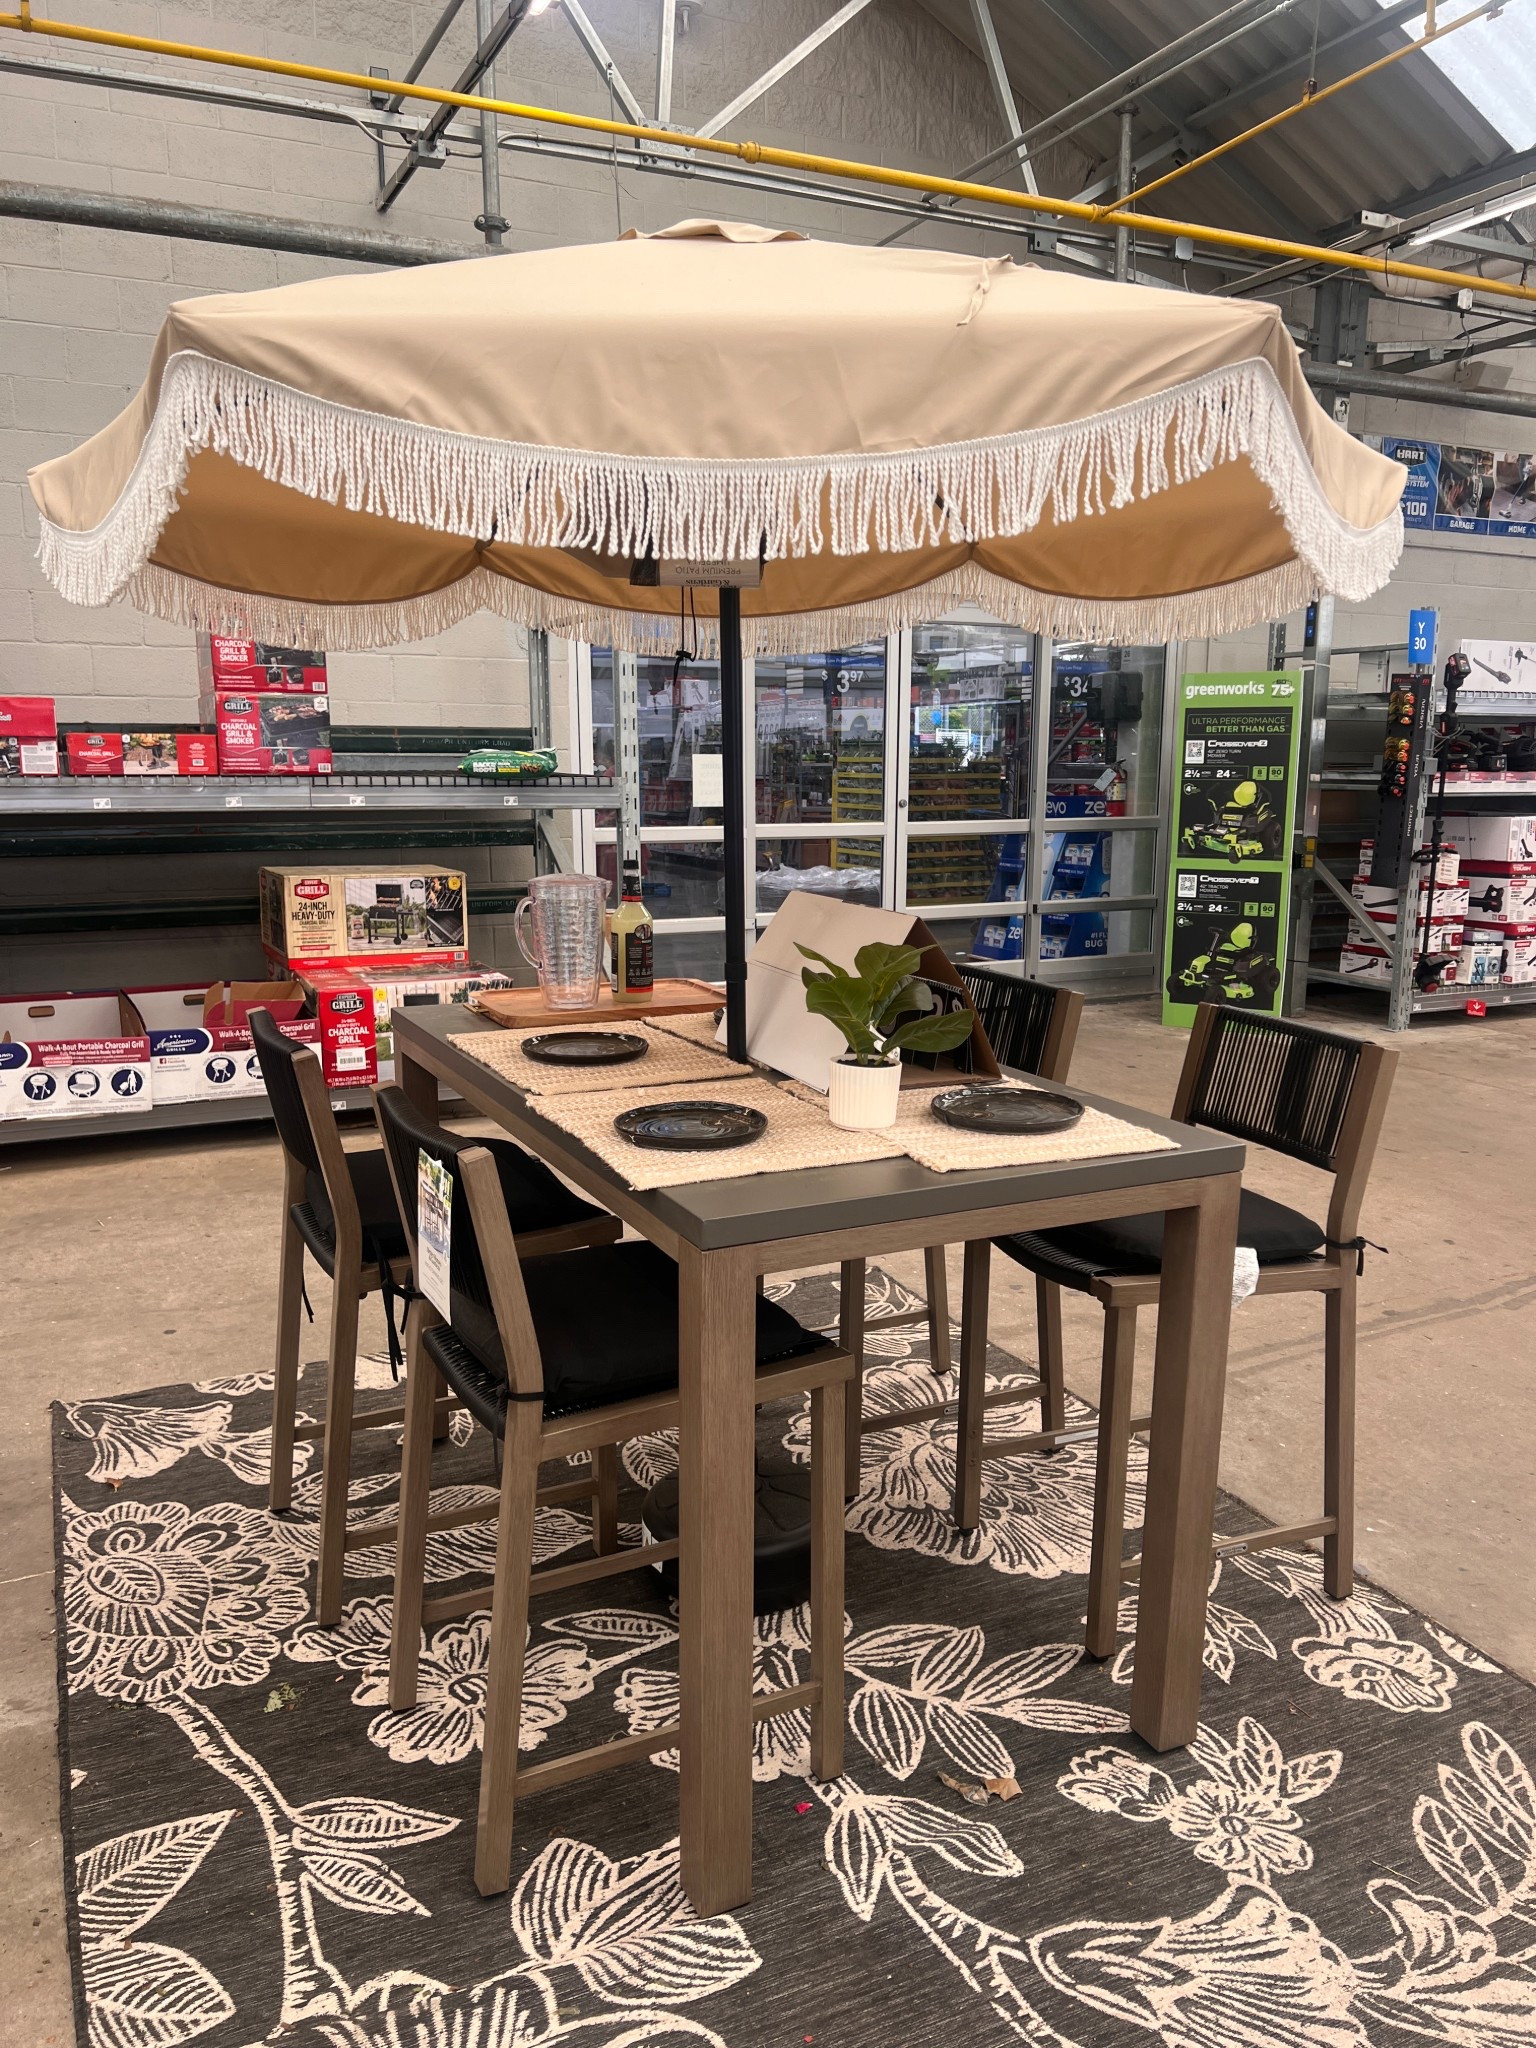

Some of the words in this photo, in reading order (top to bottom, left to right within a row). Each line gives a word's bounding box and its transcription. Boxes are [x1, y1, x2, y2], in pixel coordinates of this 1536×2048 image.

[1396, 449, 1425, 460] HART
[1450, 520, 1475, 530] GARAGE
[1508, 526, 1526, 534] HOME
[675, 566, 700, 574] PATIO
[702, 567, 741, 575] PREMIUM
[1418, 622, 1426, 634] Y
[214, 640, 252, 648] CHARCOAL
[1413, 637, 1427, 650] 30
[1185, 681, 1265, 699] greenworks
[223, 702, 252, 710] GRILL
[220, 722, 257, 730] CHARCOAL
[1220, 717, 1286, 725] PERFORMANCE
[225, 730, 246, 738] GRILL
[1206, 725, 1239, 733] BETTER
[1216, 769, 1230, 778] 24
[1045, 801, 1067, 815] evo
[1406, 804, 1414, 837] PROTECT
[296, 885, 327, 895] GRILL
[298, 901, 328, 912] 24-INCH
[1208, 904, 1222, 912] 24
[291, 910, 336, 921] HEAVY-DUTY
[1084, 939, 1103, 948] BUG
[332, 999, 363, 1010] GRILL
[279, 1024, 303, 1033] Charcoal
[303, 1022, 315, 1030] Grill
[327, 1026, 370, 1038] CHARCOAL
[153, 1038, 197, 1051] Americana
[337, 1035, 361, 1045] GRILL
[38, 1043, 77, 1053] Walk-A-Bout
[78, 1042, 104, 1051] Portable
[104, 1041, 131, 1050] Charcoal
[131, 1041, 145, 1049] Grill
